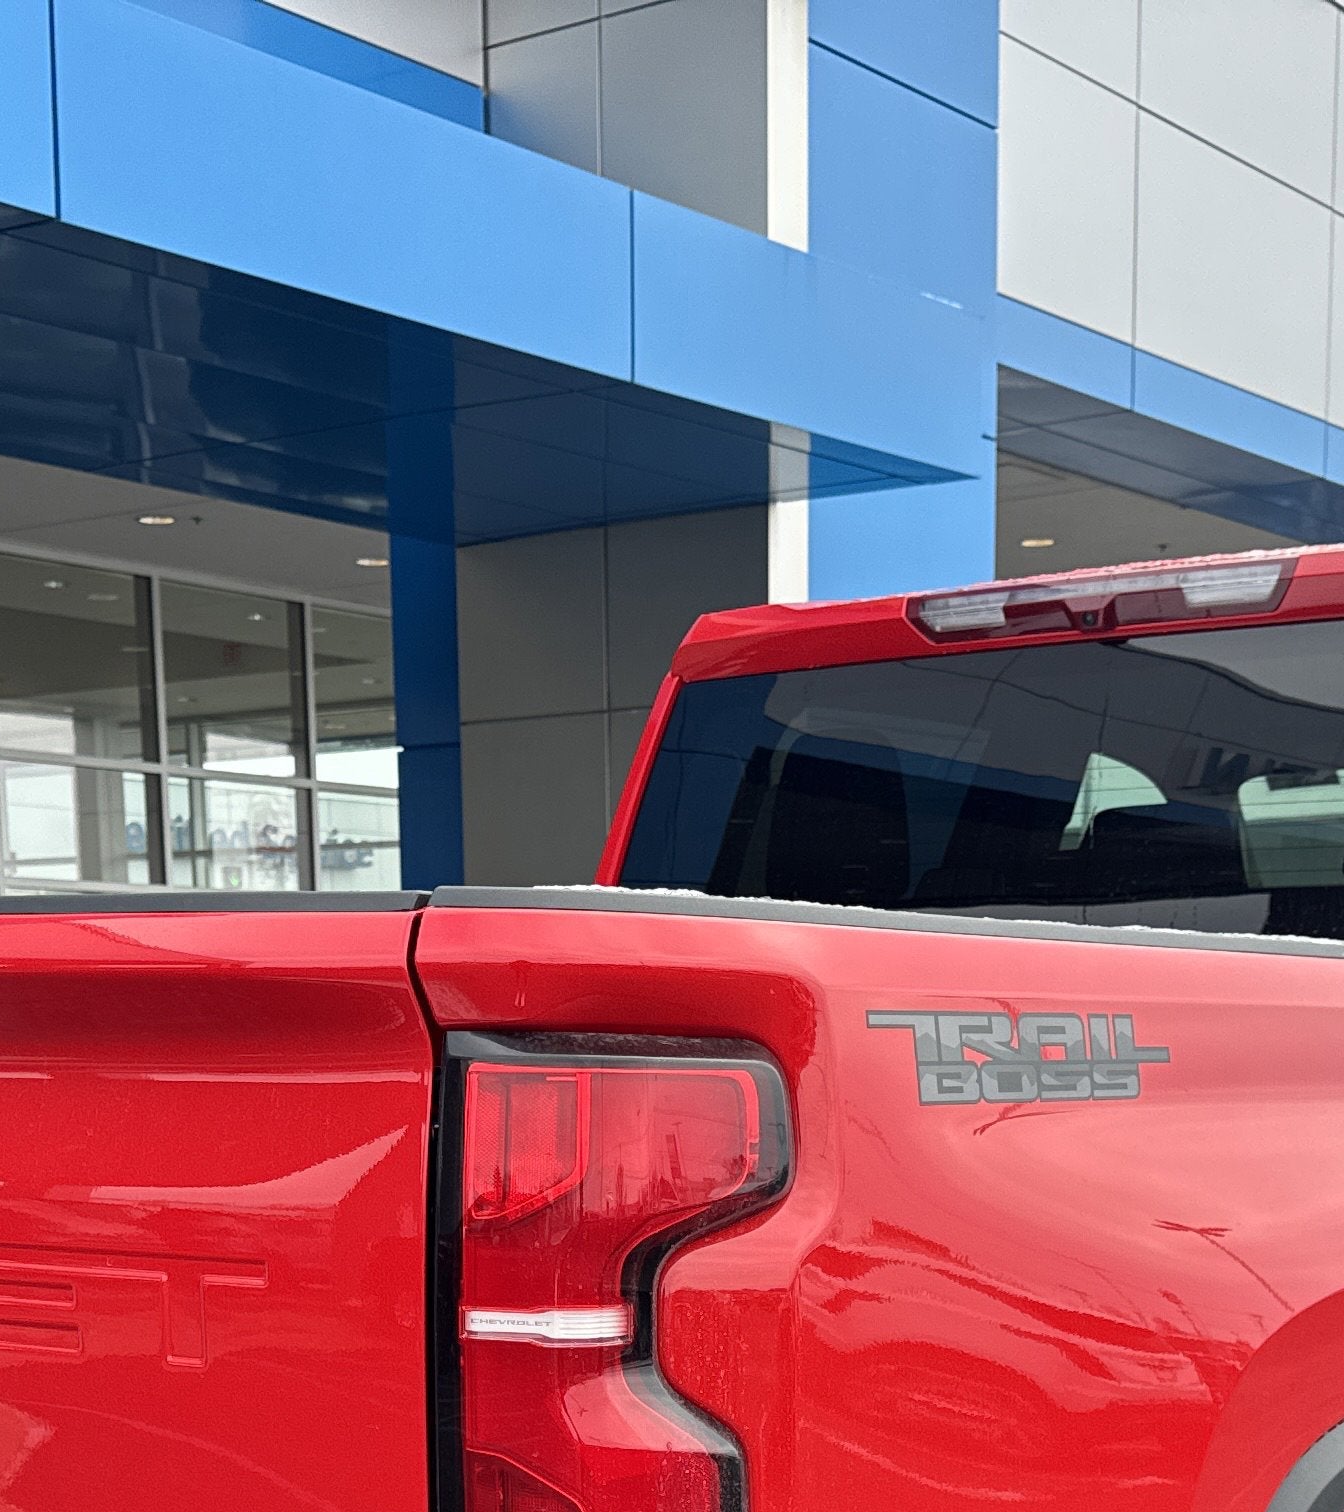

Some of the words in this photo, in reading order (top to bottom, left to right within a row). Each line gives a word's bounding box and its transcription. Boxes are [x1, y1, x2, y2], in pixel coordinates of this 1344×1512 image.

[866, 1010, 1171, 1063] TRAIL
[918, 1061, 1141, 1106] BOSS
[470, 1317, 553, 1328] CHEVROLET
